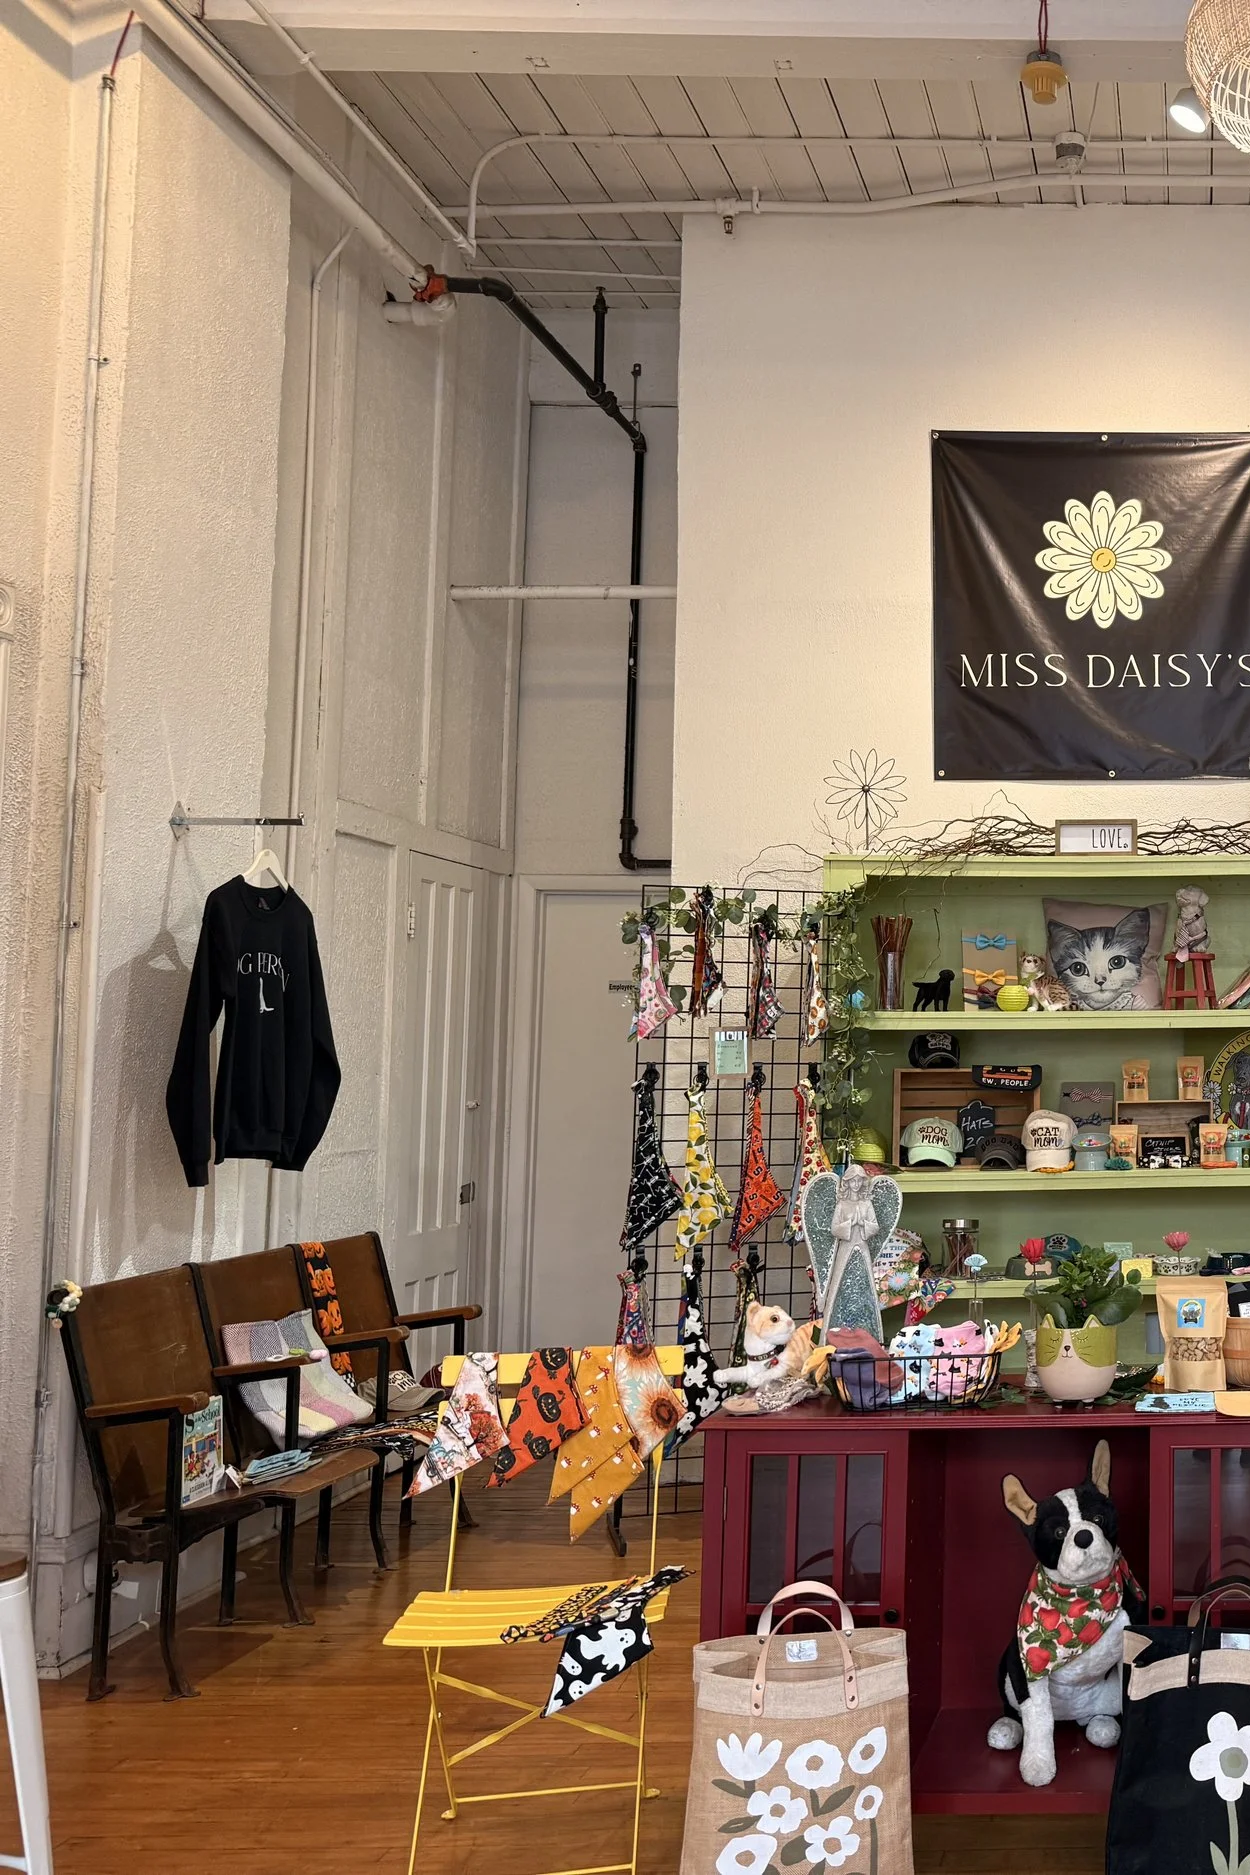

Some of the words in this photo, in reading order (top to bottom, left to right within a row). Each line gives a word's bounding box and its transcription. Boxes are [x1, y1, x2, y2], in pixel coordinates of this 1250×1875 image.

[960, 653, 1067, 687] MISS
[925, 1125, 948, 1137] DOG
[1037, 1126, 1060, 1136] CAT
